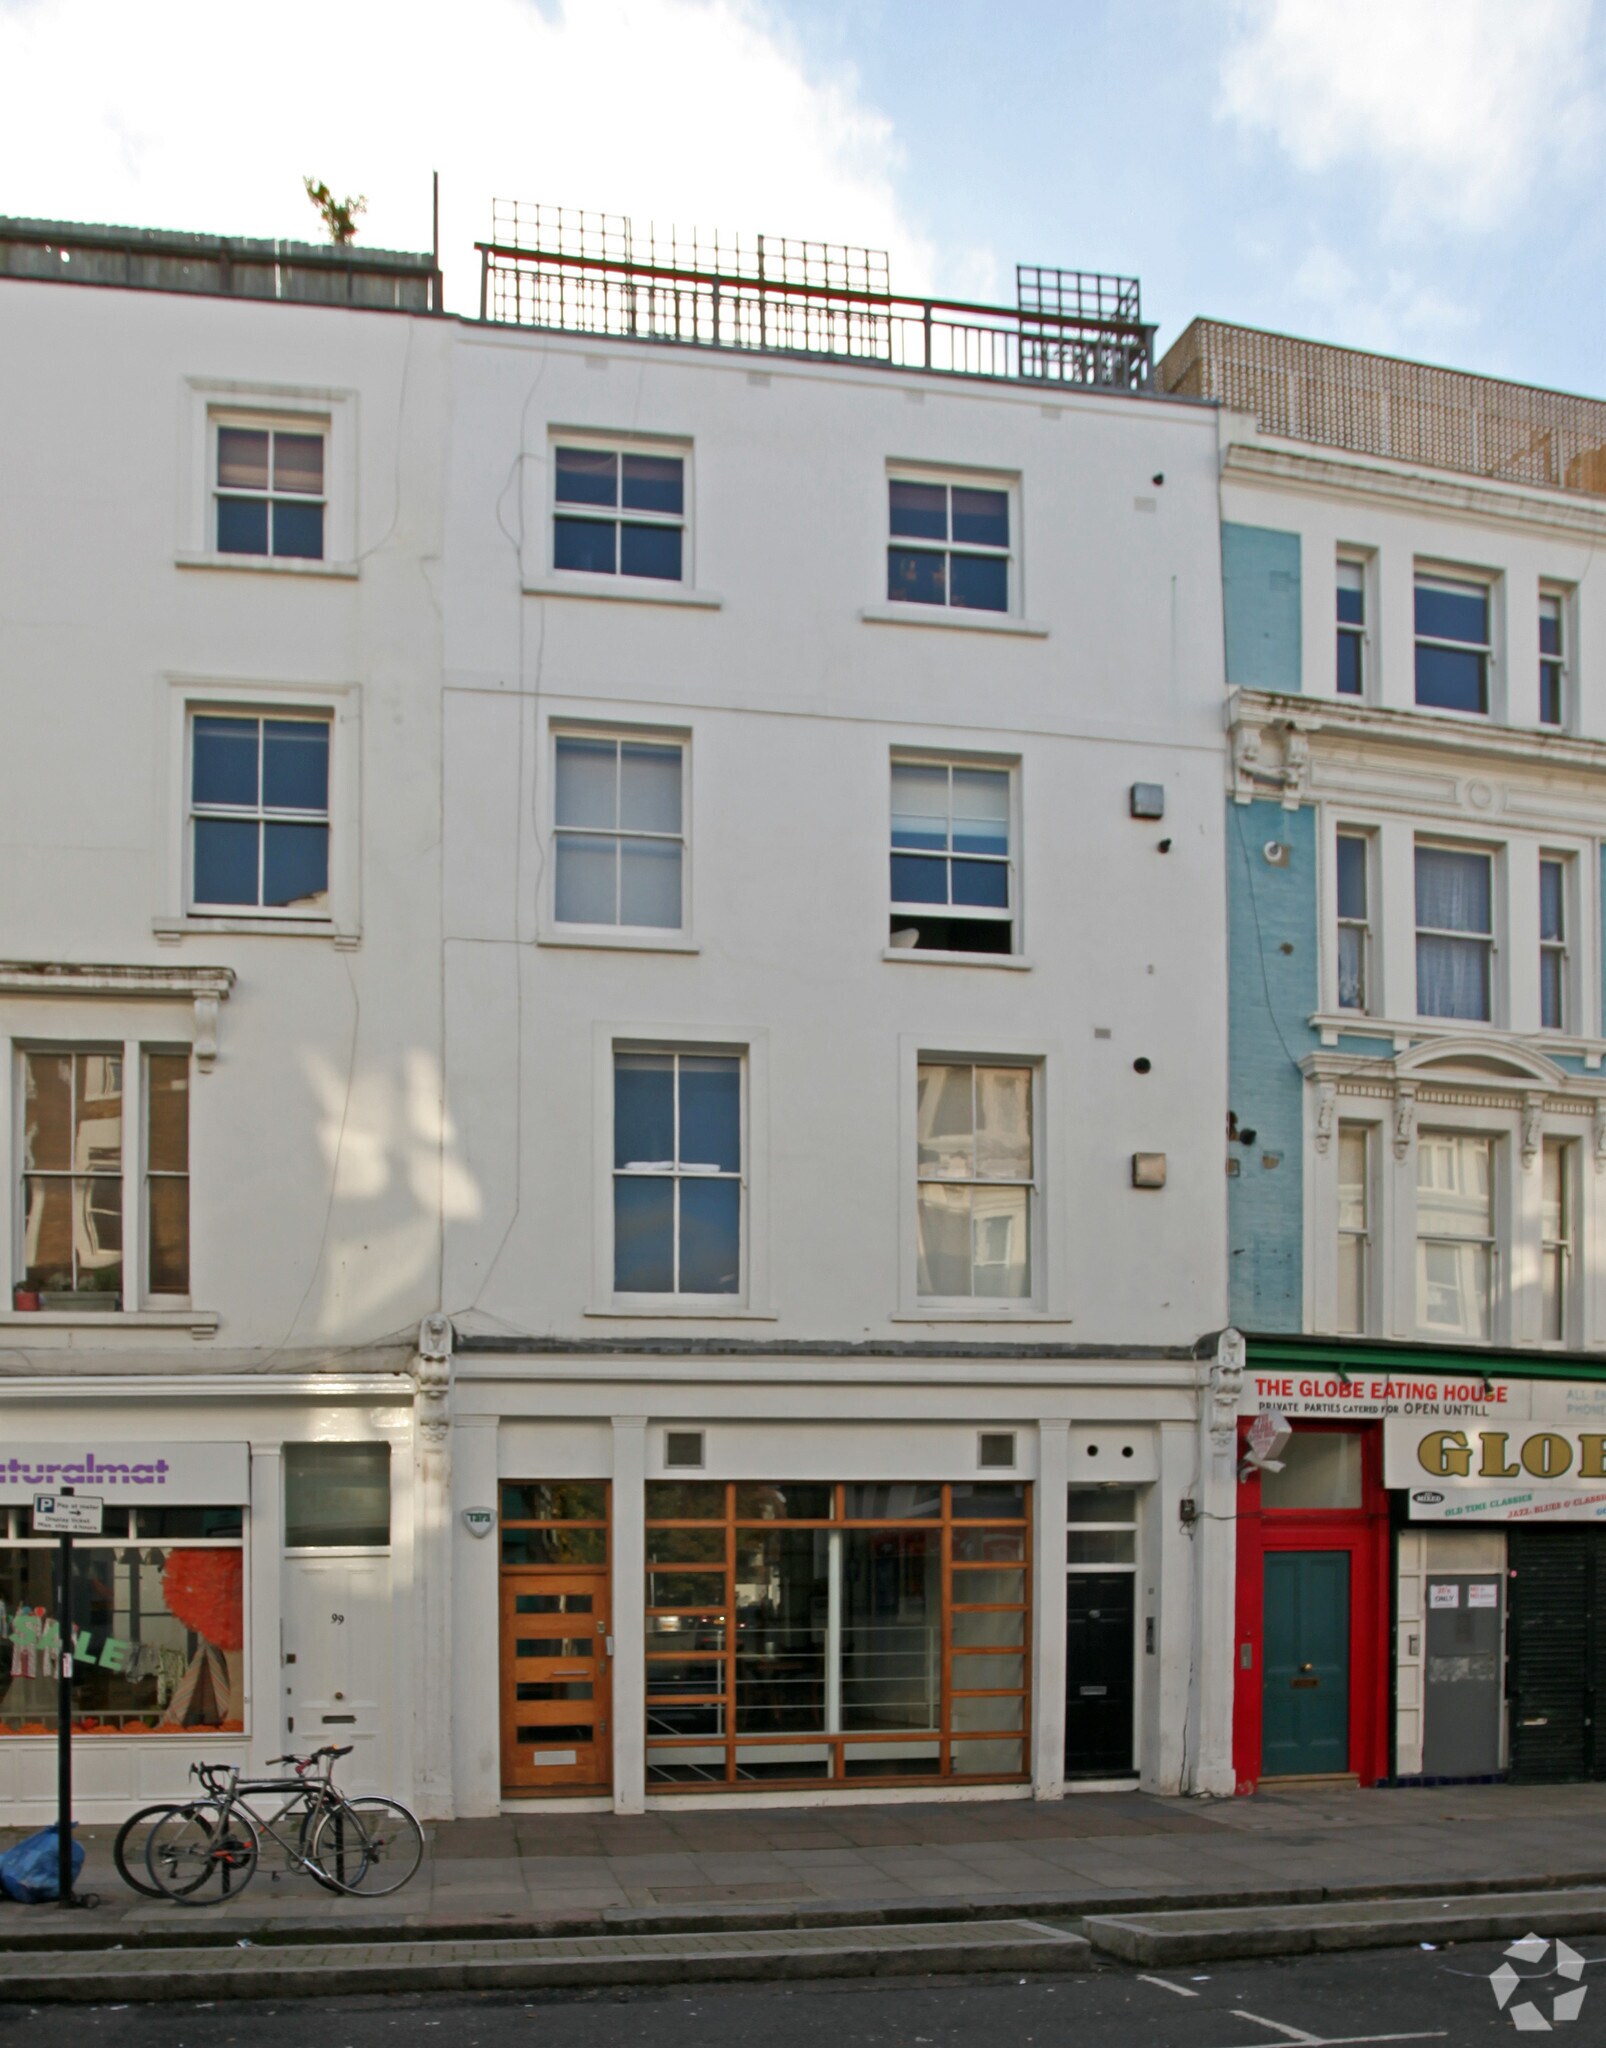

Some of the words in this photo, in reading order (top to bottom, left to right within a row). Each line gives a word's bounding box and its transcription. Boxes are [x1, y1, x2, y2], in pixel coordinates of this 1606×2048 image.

[1255, 1378, 1293, 1397] THE
[1299, 1380, 1365, 1398] GLOBE
[1371, 1382, 1437, 1401] EATING
[1304, 1402, 1341, 1413] PARTIES
[1342, 1404, 1379, 1414] CATERED
[1381, 1405, 1399, 1413] FOR
[1403, 1402, 1440, 1415] OPEN
[1443, 1404, 1489, 1417] UNTILL
[0, 1453, 169, 1484] turalmat
[1445, 1506, 1463, 1517] OLD
[1465, 1502, 1487, 1514] TIME
[331, 1613, 344, 1625] 99
